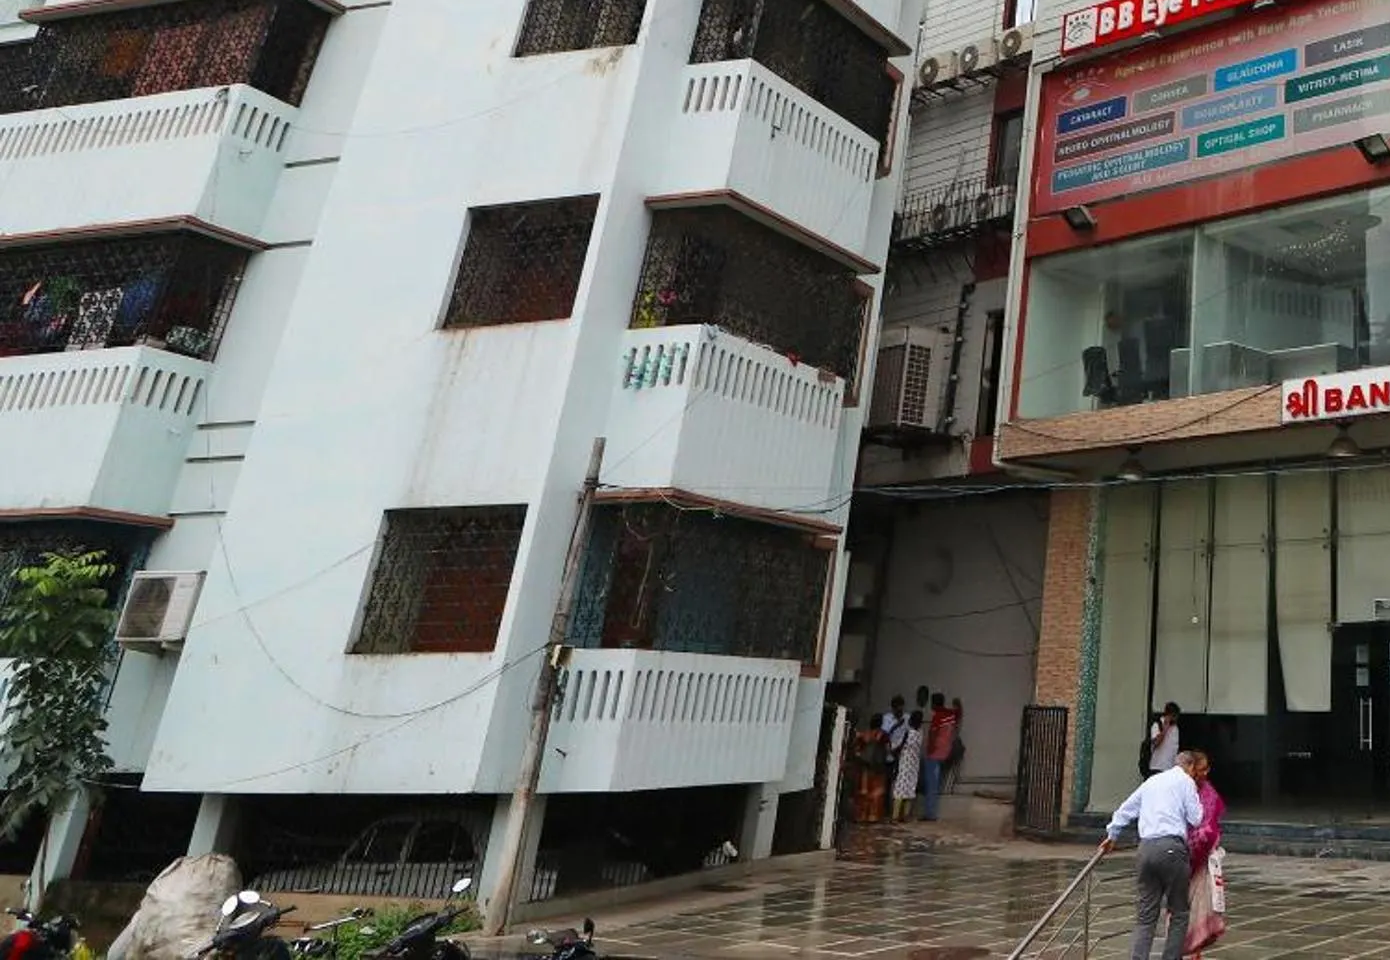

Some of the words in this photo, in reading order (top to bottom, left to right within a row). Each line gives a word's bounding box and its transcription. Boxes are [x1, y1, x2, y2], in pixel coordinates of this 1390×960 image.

[1226, 59, 1284, 83] GLAUCOMA
[1204, 131, 1245, 150] OPTICAL
[1248, 123, 1277, 139] SHOP
[1286, 379, 1319, 419] श्री
